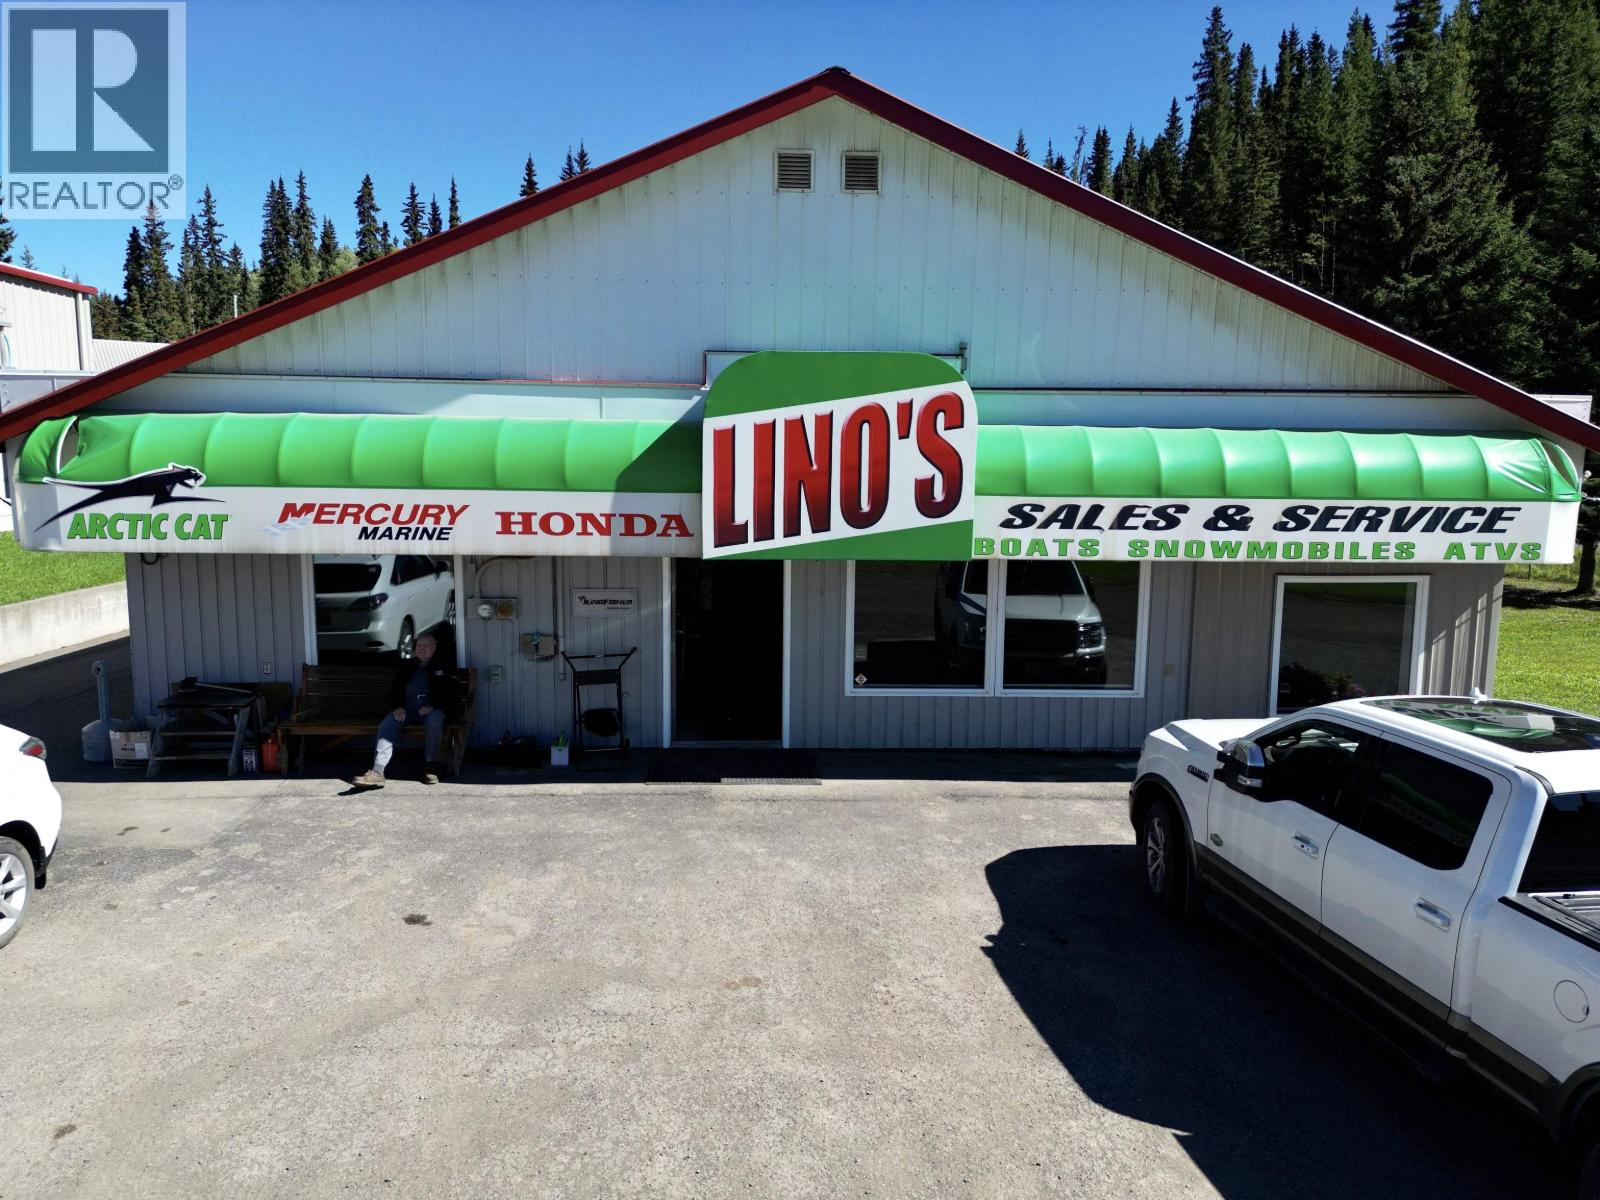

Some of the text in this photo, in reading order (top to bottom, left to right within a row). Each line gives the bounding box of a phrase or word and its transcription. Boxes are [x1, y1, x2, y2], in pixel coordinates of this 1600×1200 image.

[713, 391, 965, 548] LINO'S
[66, 512, 230, 540] ARCTIC CAT
[277, 502, 470, 526] MERCURY
[494, 511, 695, 538] HONDA
[998, 503, 1522, 534] SALES & SERVICE
[357, 526, 453, 541] MARINE
[974, 537, 1542, 561] BOATS SNOWMOBILES ATVS
